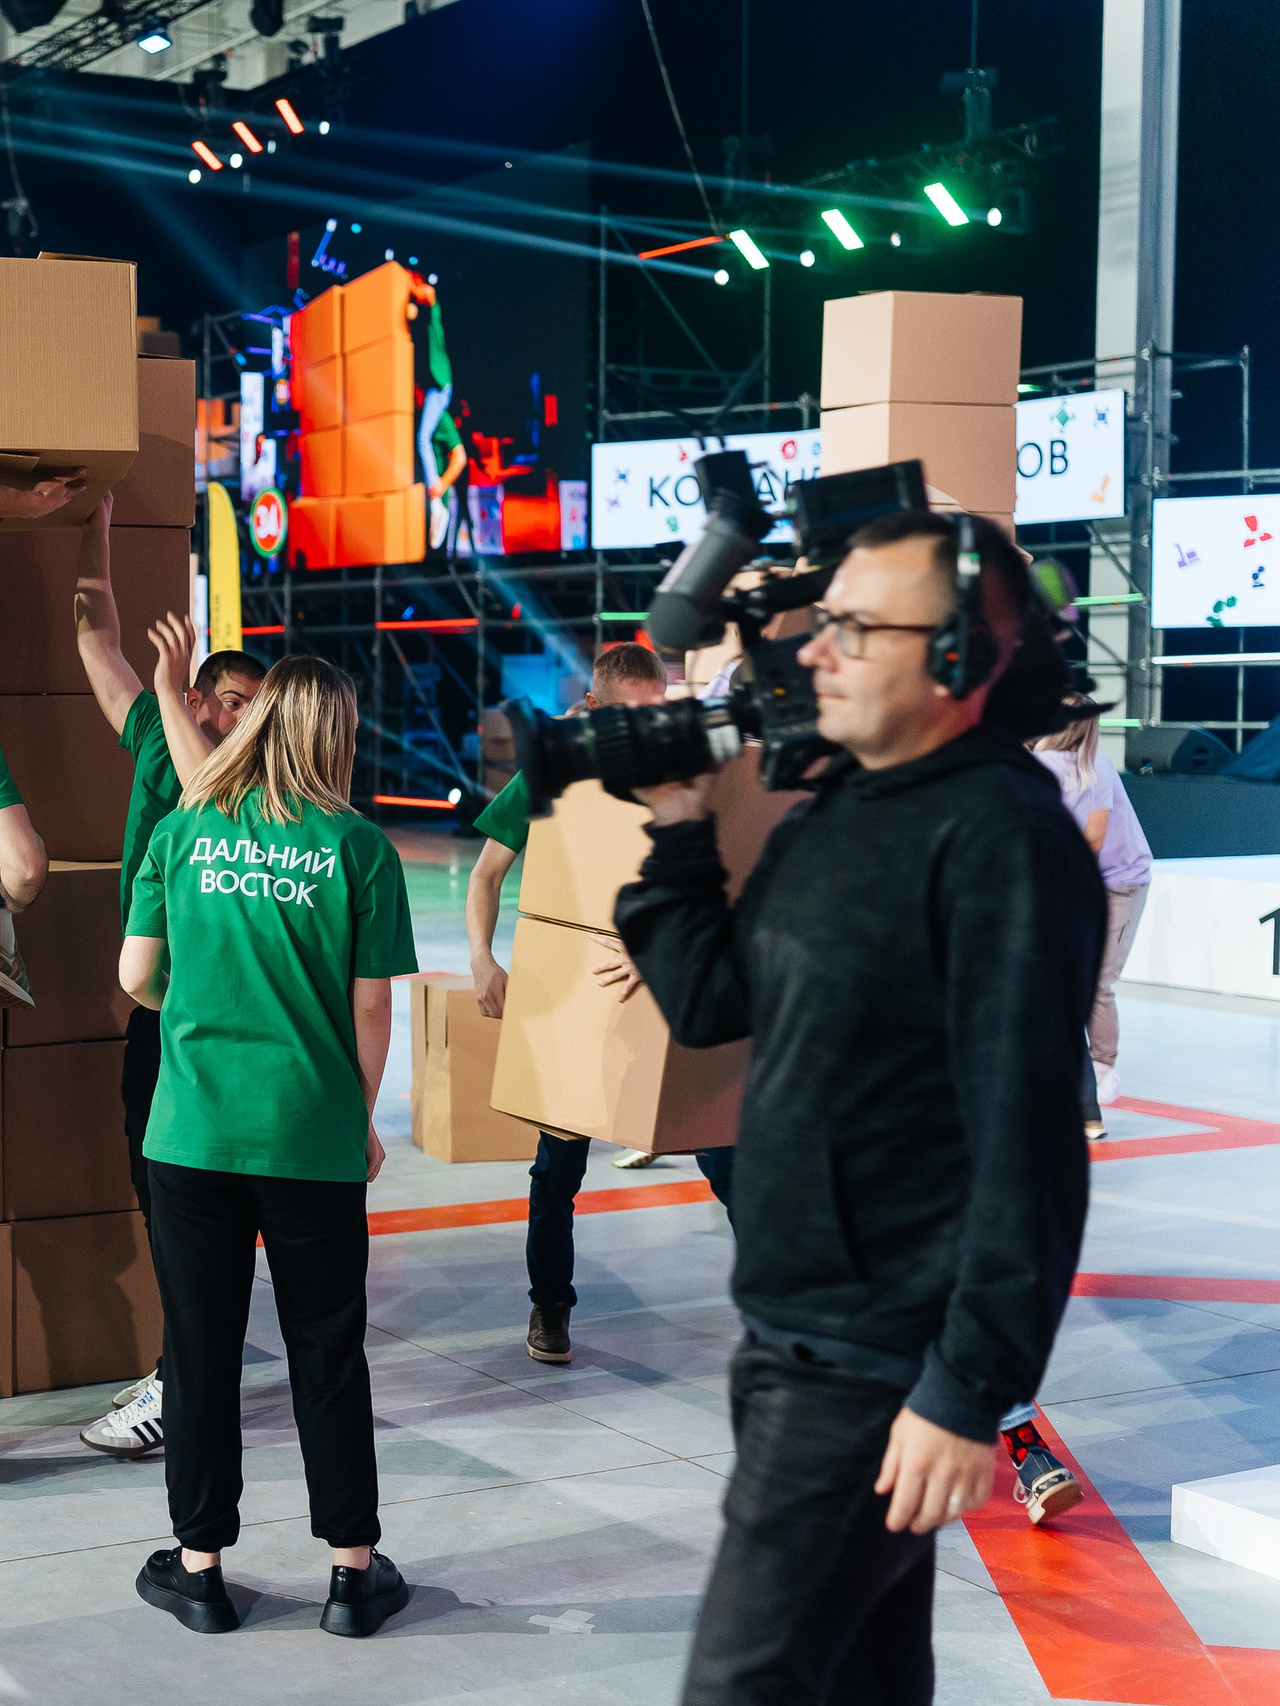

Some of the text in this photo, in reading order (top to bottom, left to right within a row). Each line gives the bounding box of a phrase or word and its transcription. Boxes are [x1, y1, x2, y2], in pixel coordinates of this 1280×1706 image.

[1016, 439, 1069, 479] ОВ
[189, 837, 337, 879] ДАЛЬНИЙ
[200, 869, 319, 909] ВОСТОК
